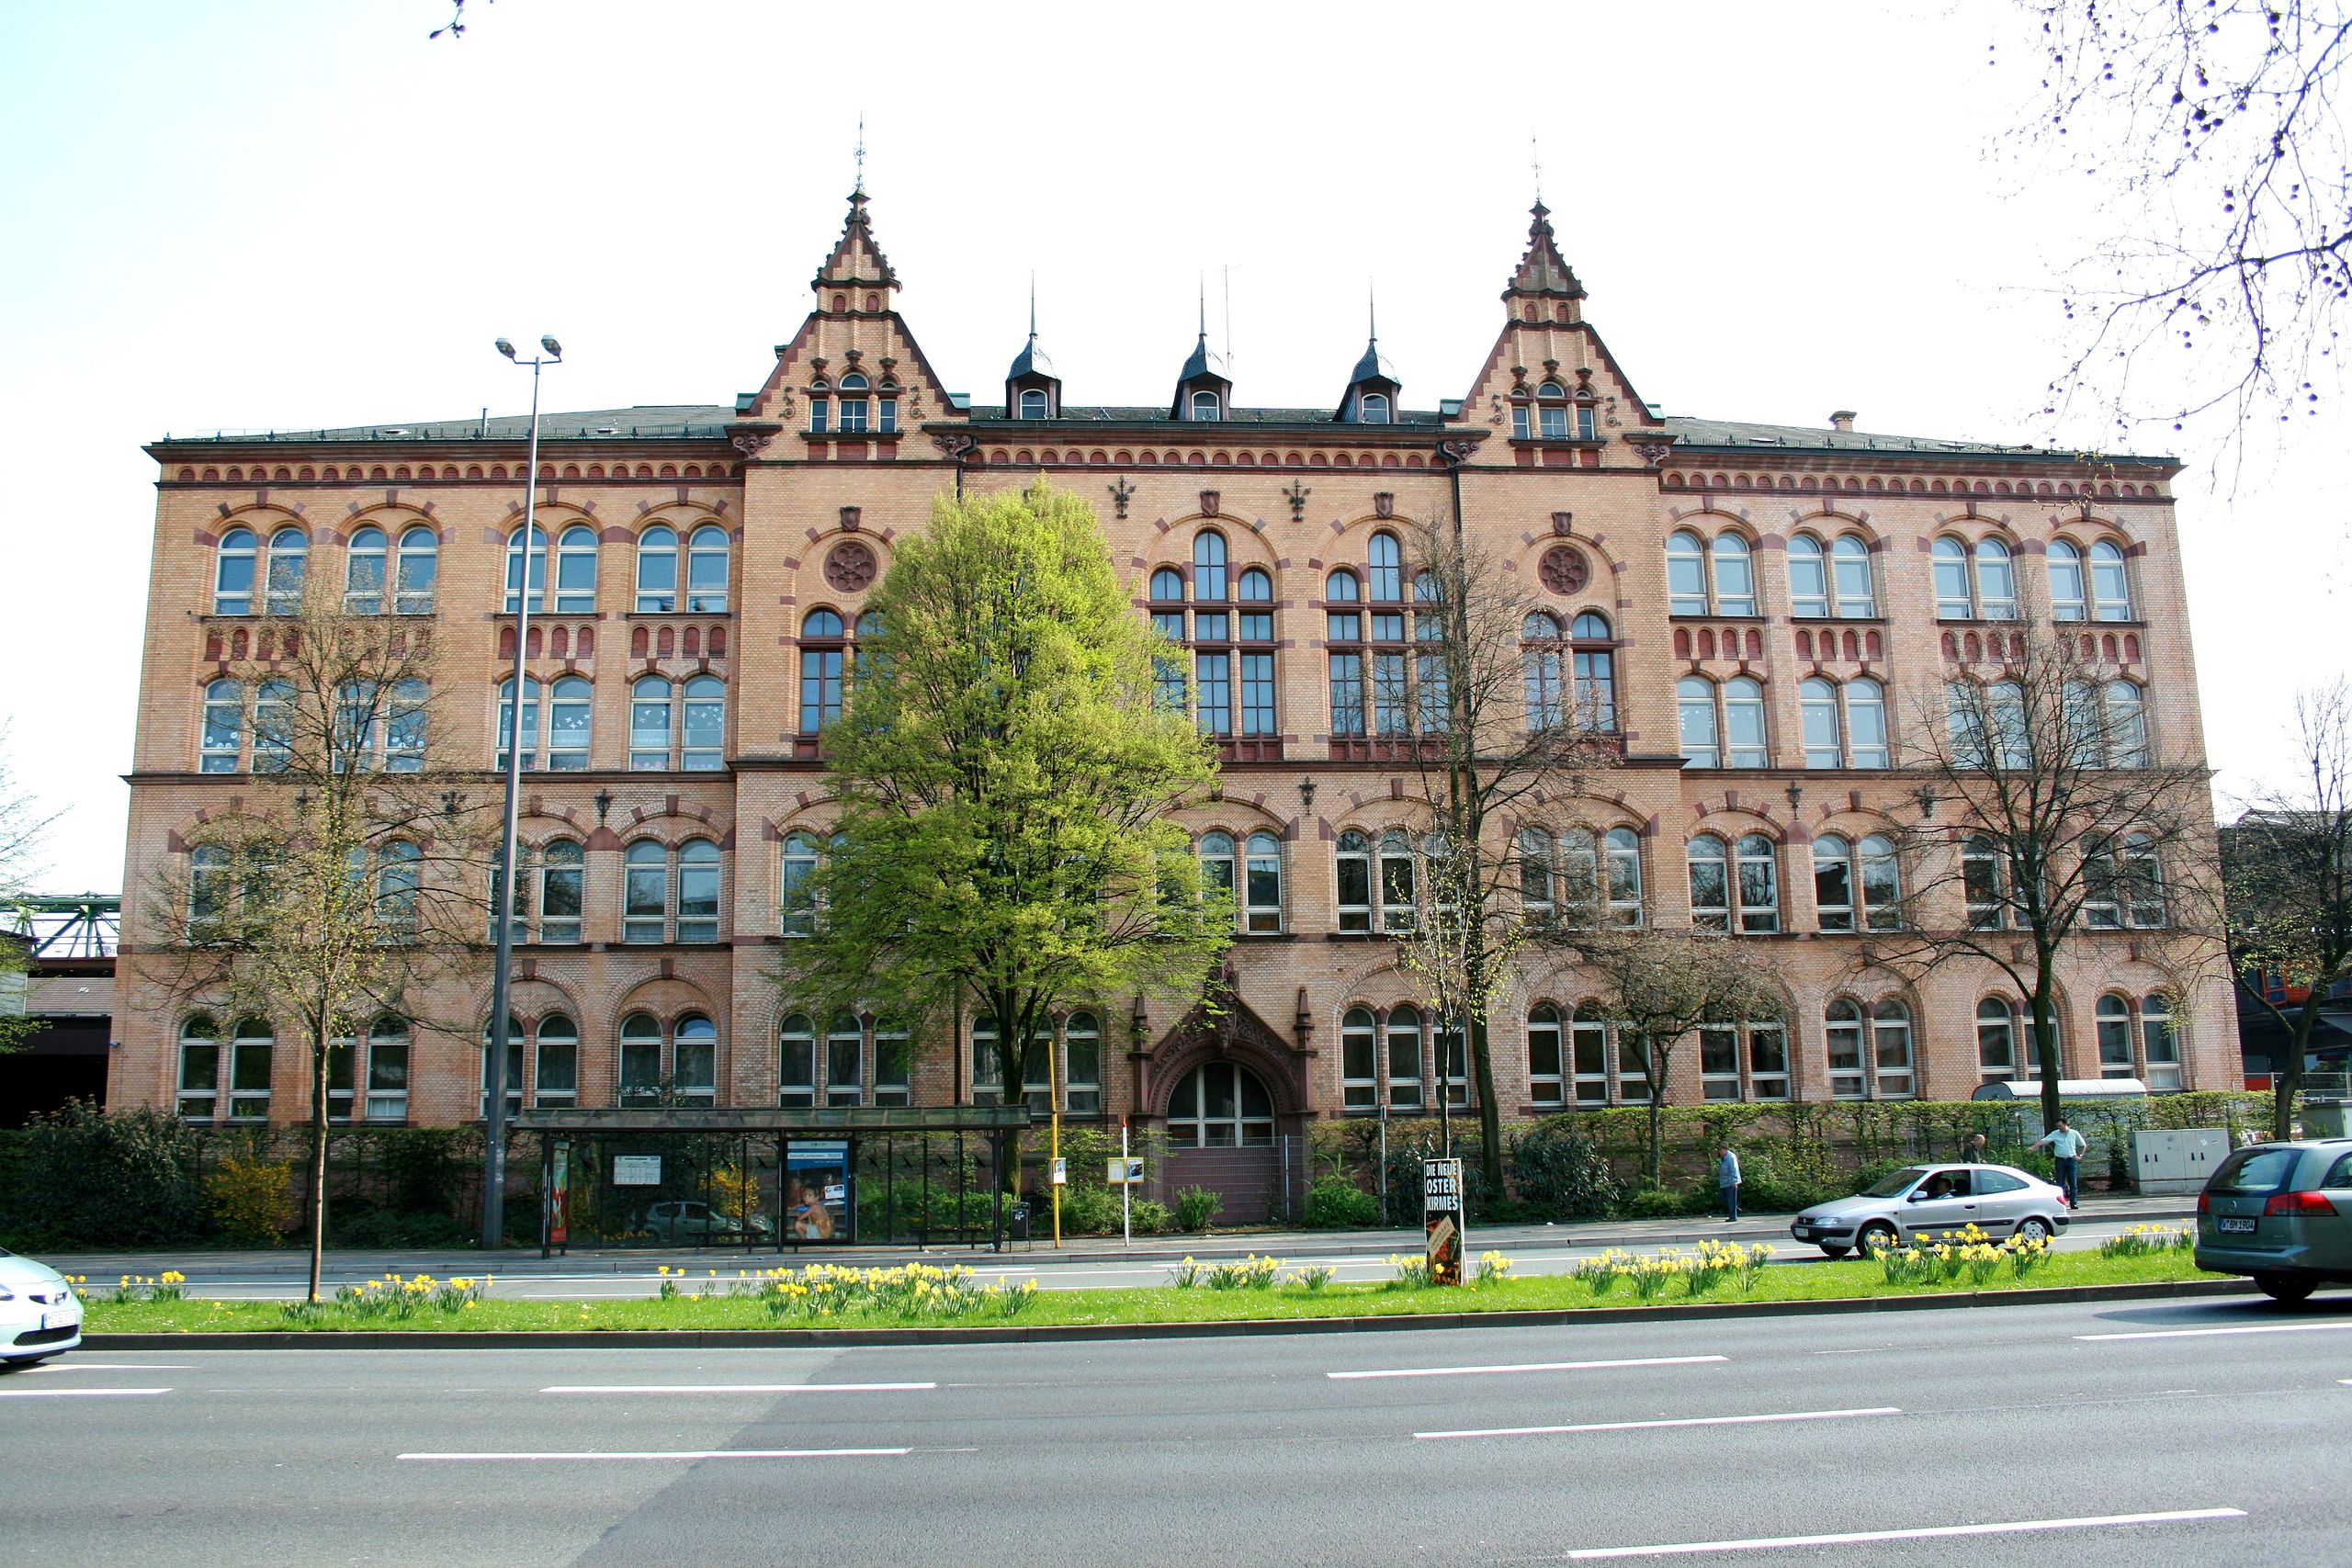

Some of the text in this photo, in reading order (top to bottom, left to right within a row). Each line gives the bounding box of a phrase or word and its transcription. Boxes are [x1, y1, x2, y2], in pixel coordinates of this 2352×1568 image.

[1426, 1163, 1457, 1177] DIE NEUE
[1426, 1179, 1457, 1194] OSTER
[1426, 1196, 1458, 1211] KIRMES
